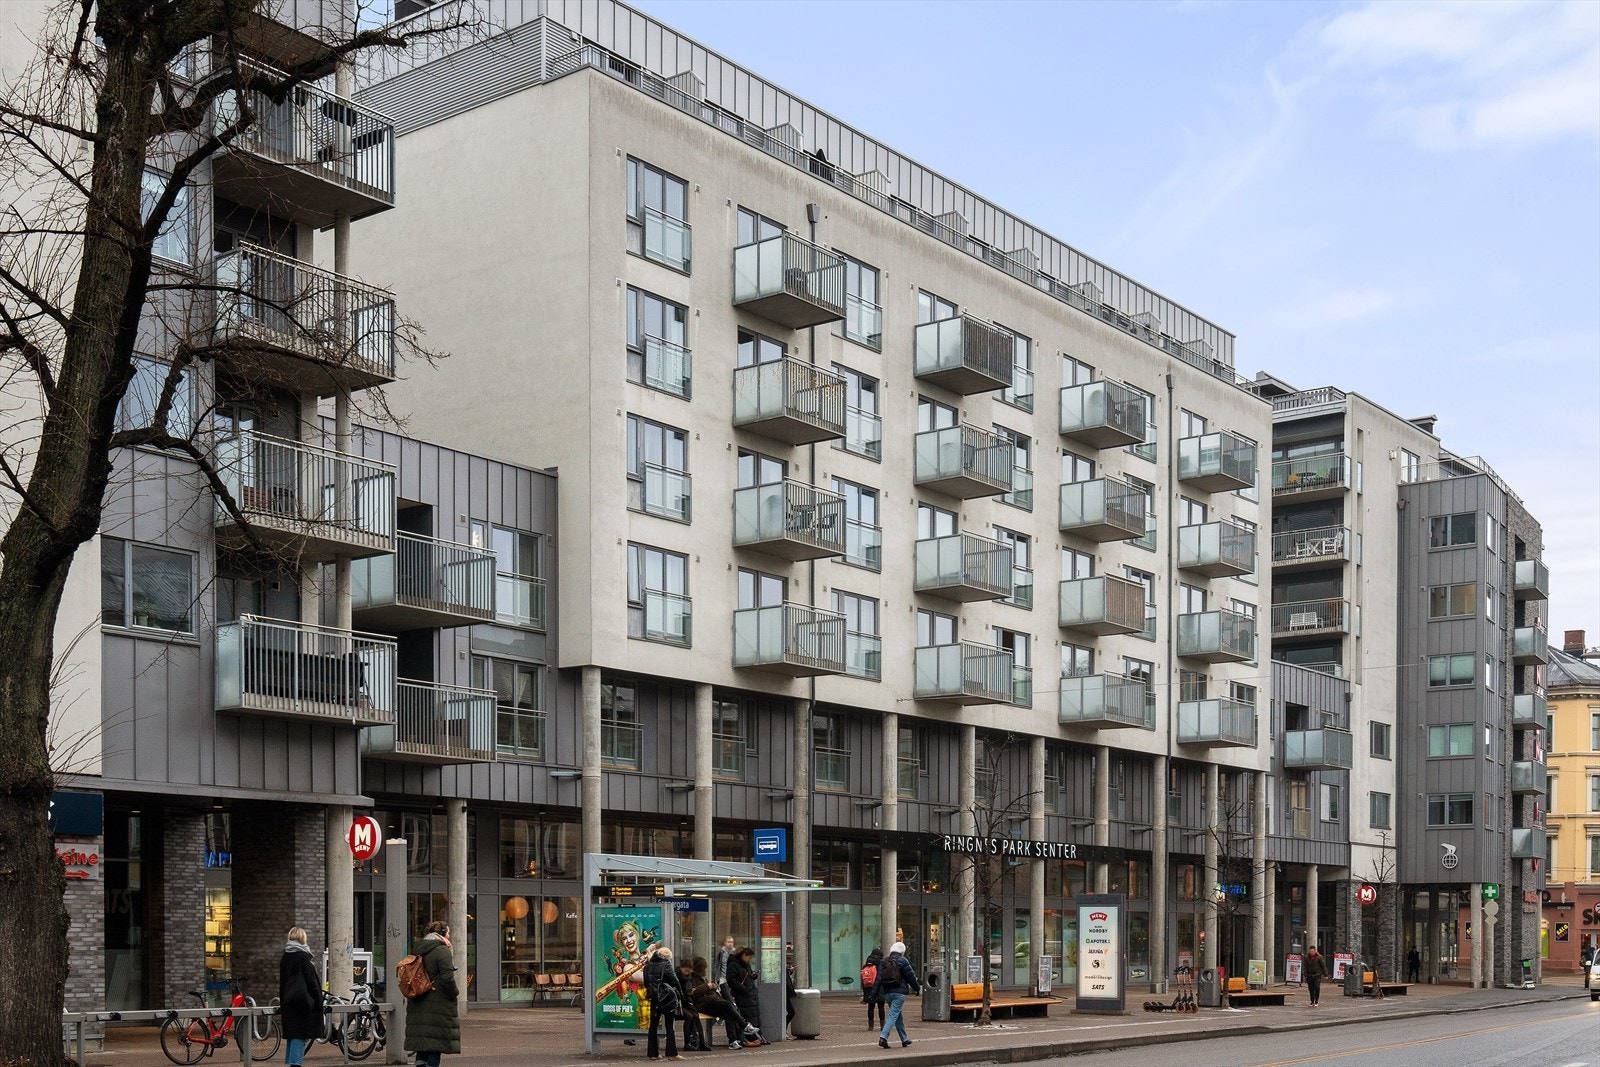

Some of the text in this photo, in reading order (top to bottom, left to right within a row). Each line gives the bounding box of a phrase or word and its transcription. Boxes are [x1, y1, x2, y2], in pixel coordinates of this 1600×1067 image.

[54, 848, 98, 865] isine
[1002, 839, 1031, 856] PARK
[1035, 842, 1077, 859] SENTER
